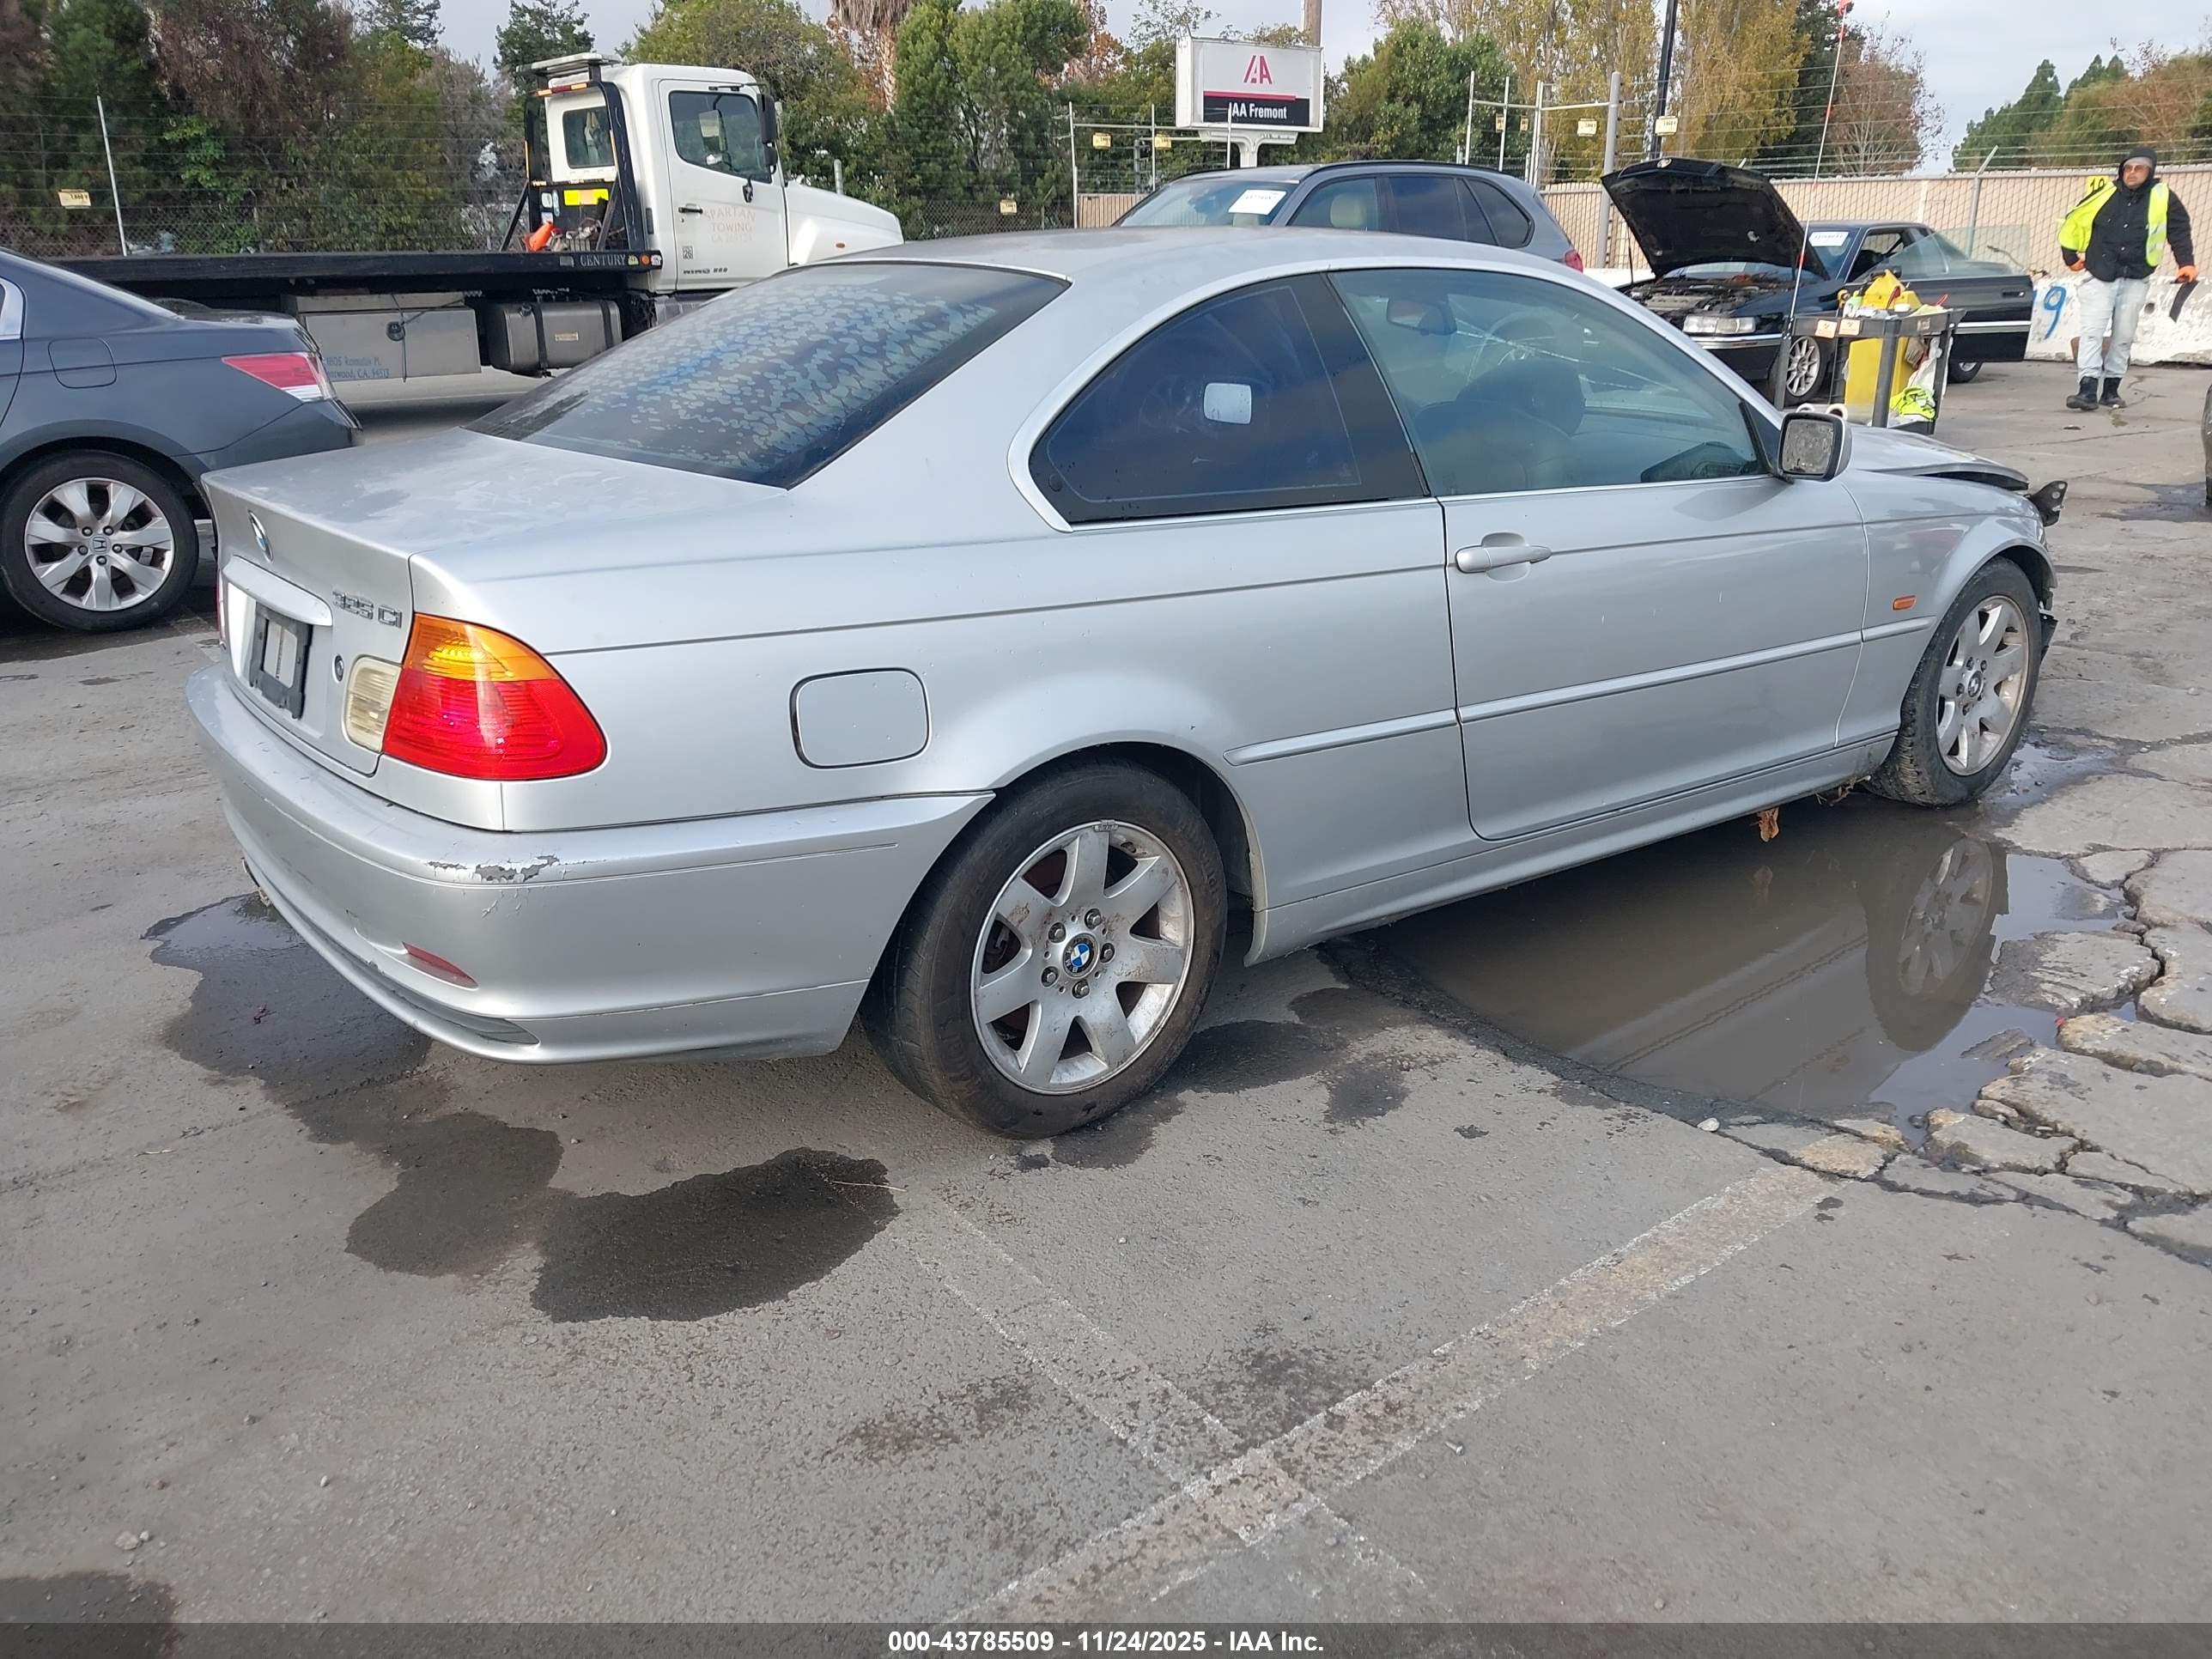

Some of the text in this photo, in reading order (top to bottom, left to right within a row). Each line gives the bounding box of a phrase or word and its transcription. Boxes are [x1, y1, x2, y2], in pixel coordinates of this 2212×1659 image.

[1249, 103, 1287, 119] Fremont
[712, 221, 753, 234] TOWING
[580, 254, 626, 267] CENTURY
[332, 591, 374, 620] 325
